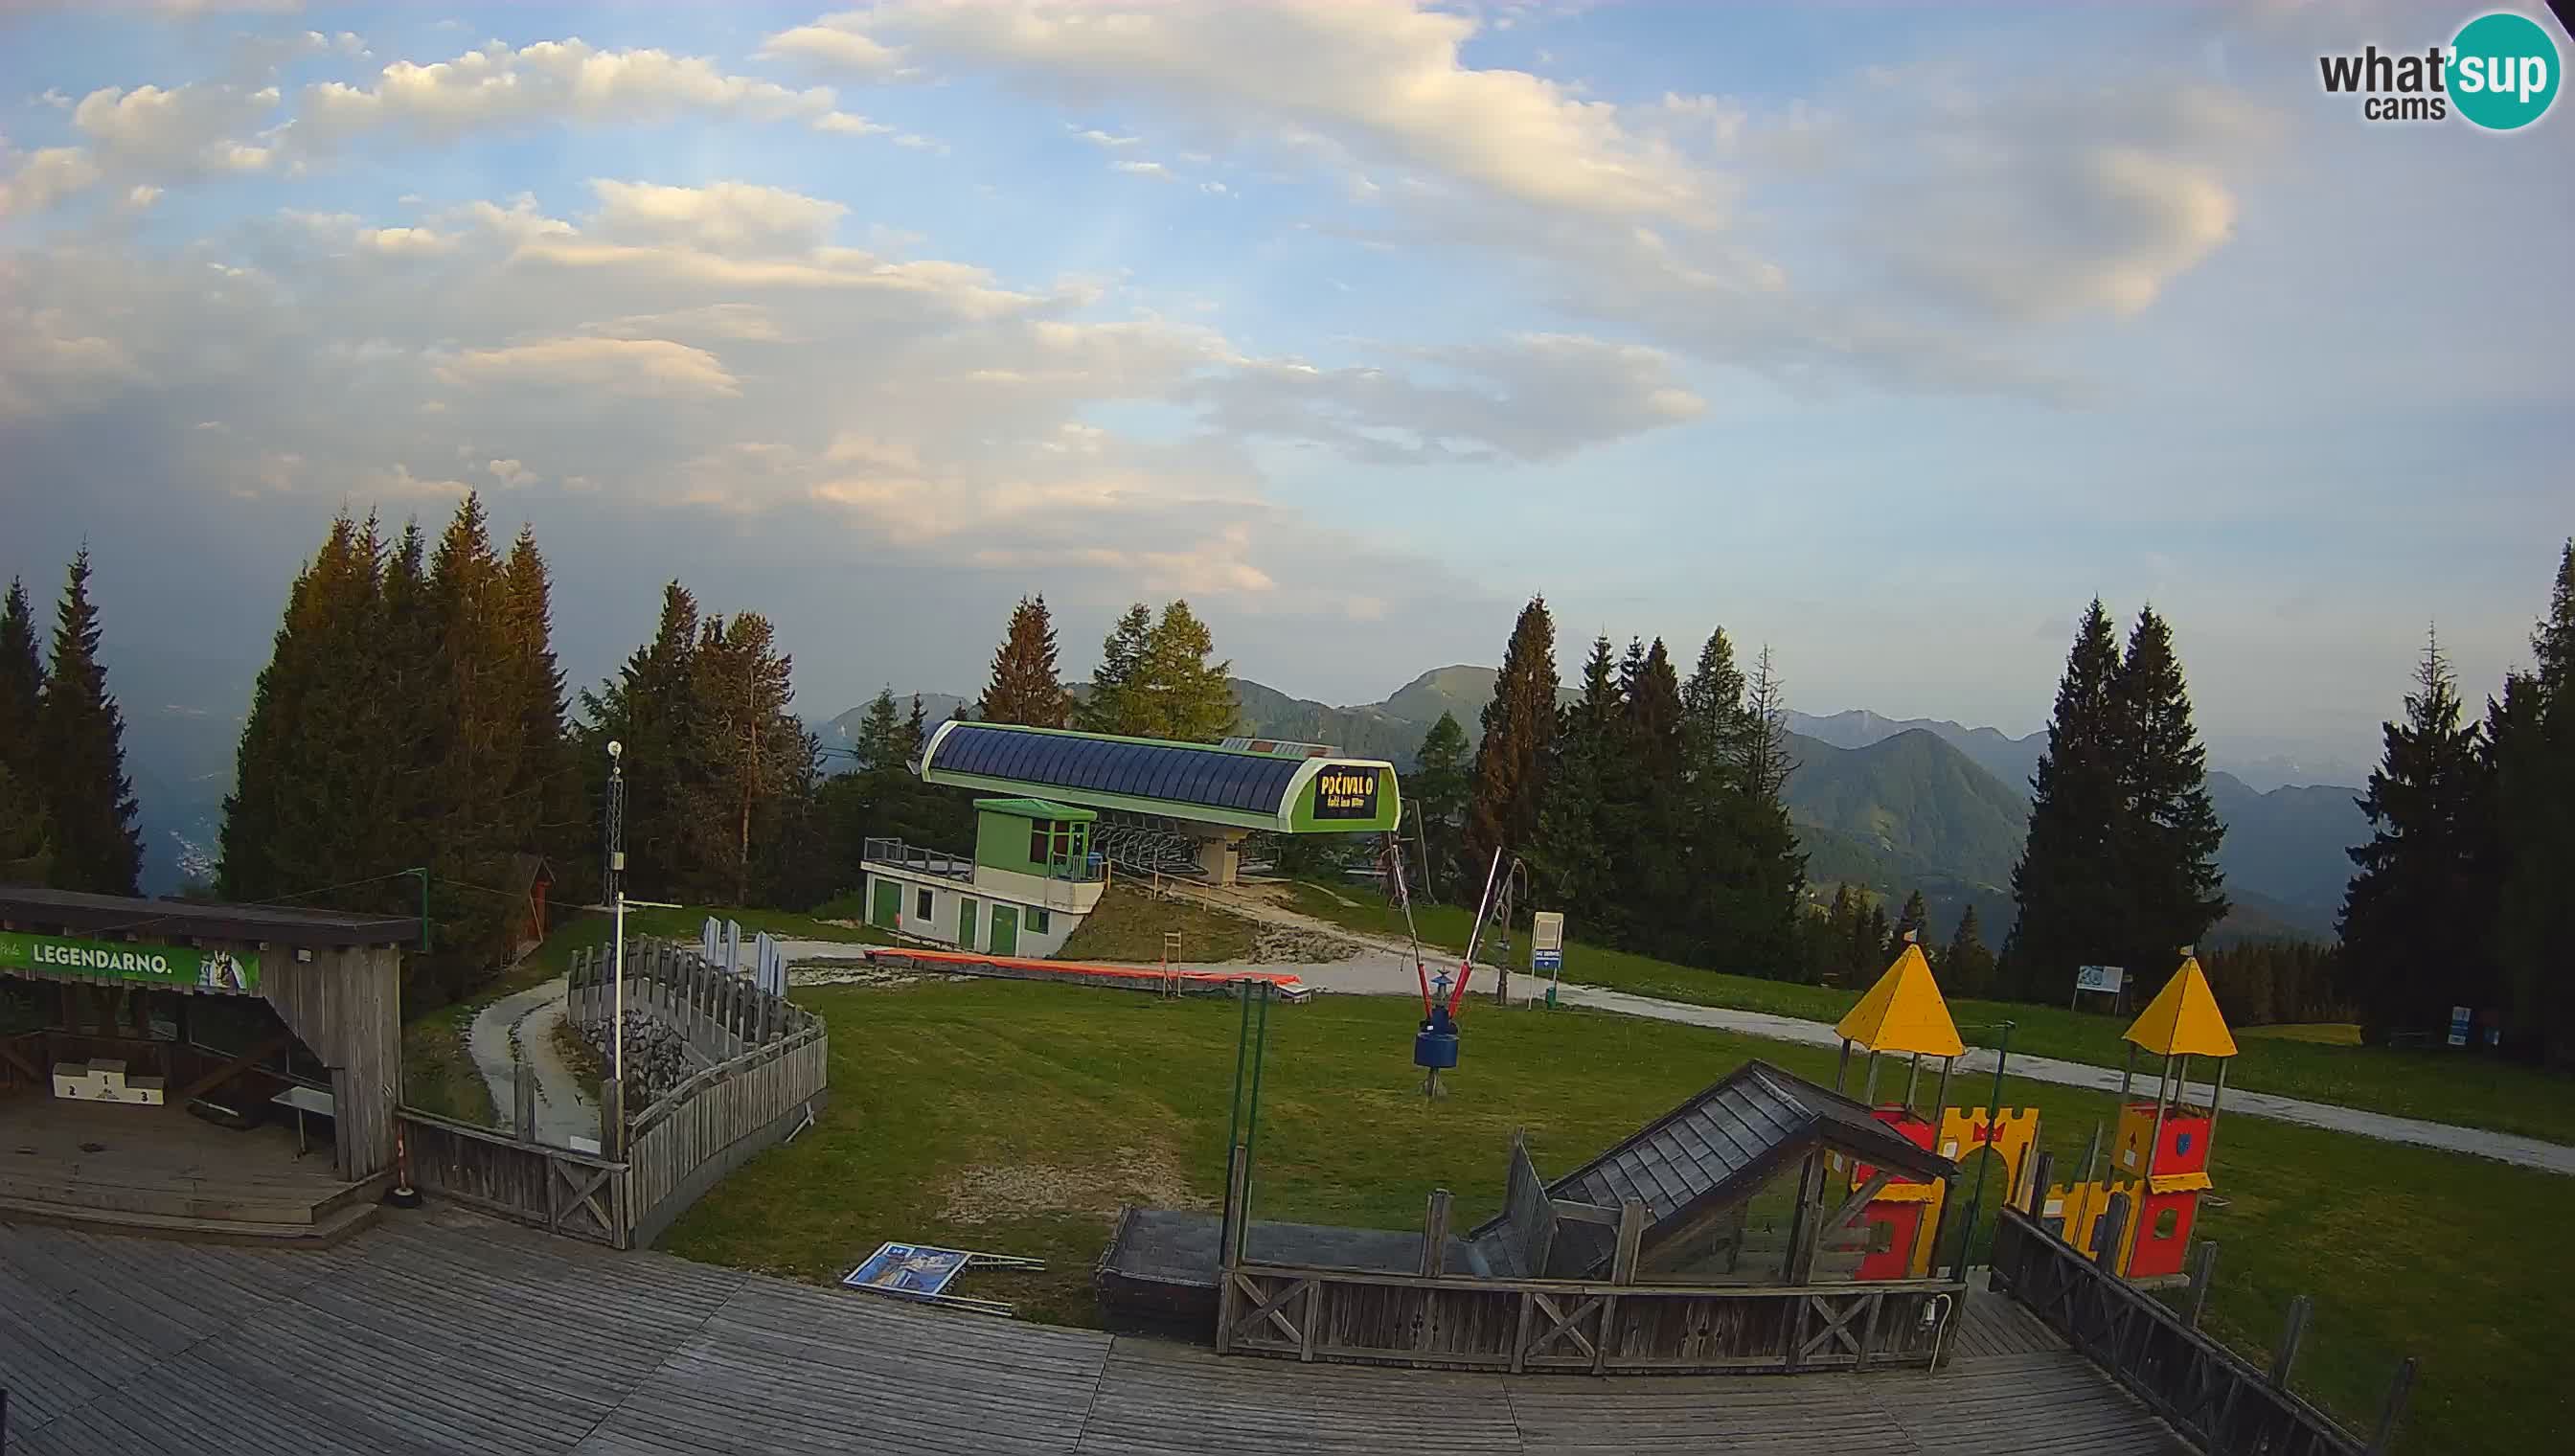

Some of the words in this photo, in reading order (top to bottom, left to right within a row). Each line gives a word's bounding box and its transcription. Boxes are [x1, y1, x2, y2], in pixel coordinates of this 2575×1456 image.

[33, 943, 173, 975] LEGENDARNO.
[103, 1075, 109, 1086] 1
[68, 1084, 76, 1097] 2
[140, 1090, 149, 1103] 3
